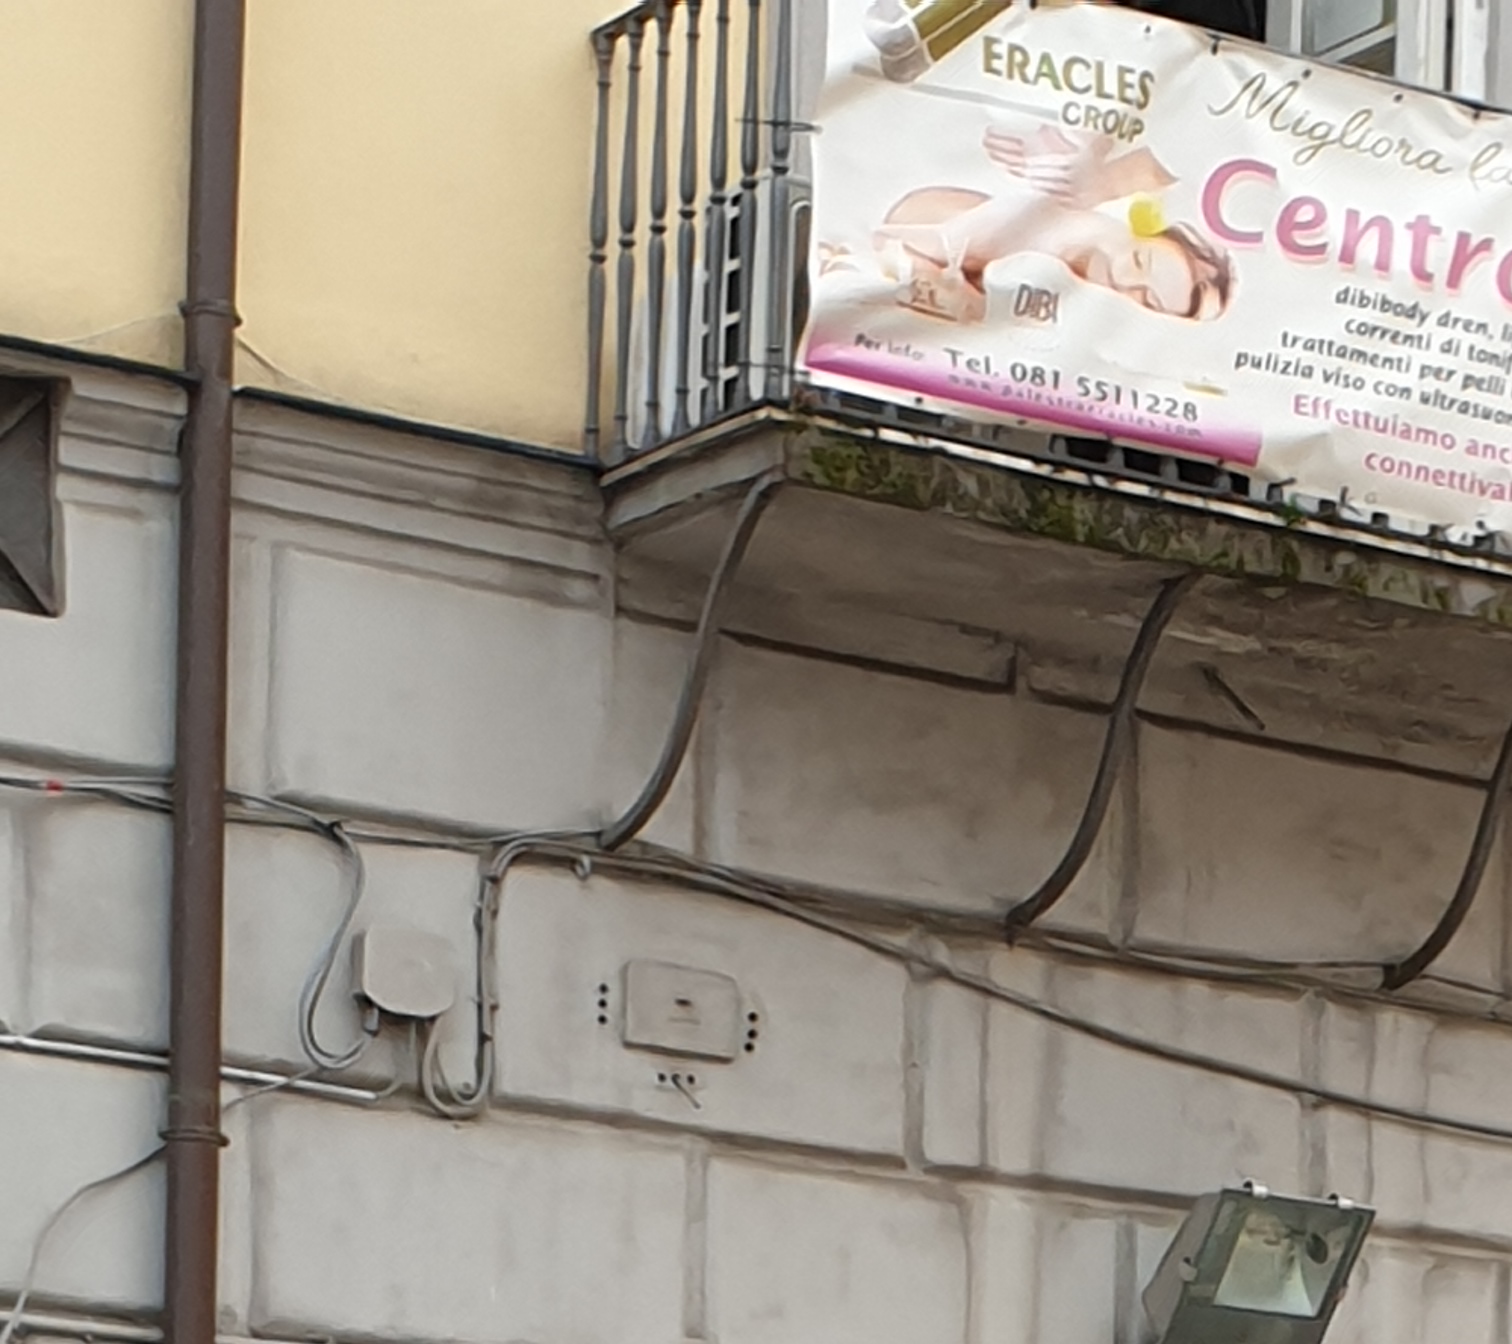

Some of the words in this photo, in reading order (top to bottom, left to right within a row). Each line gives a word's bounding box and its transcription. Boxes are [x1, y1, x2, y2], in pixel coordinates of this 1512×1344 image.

[982, 36, 1156, 110] ERACLES
[1061, 101, 1145, 143] GROUP
[1207, 72, 1454, 174] Migliora
[1334, 286, 1432, 326] dibibody
[1280, 331, 1411, 373] trattamenti
[1419, 361, 1456, 383] per
[1461, 373, 1506, 396] pelli
[1344, 318, 1432, 351] correnti
[1440, 338, 1461, 357] di
[943, 348, 999, 378] Tel.
[1010, 362, 1063, 390] 081
[1076, 376, 1200, 423] 5511228
[1234, 350, 1314, 379] pulizia
[1321, 366, 1366, 391] viso
[1372, 380, 1412, 400] con
[1293, 394, 1457, 450] Effettuiamo
